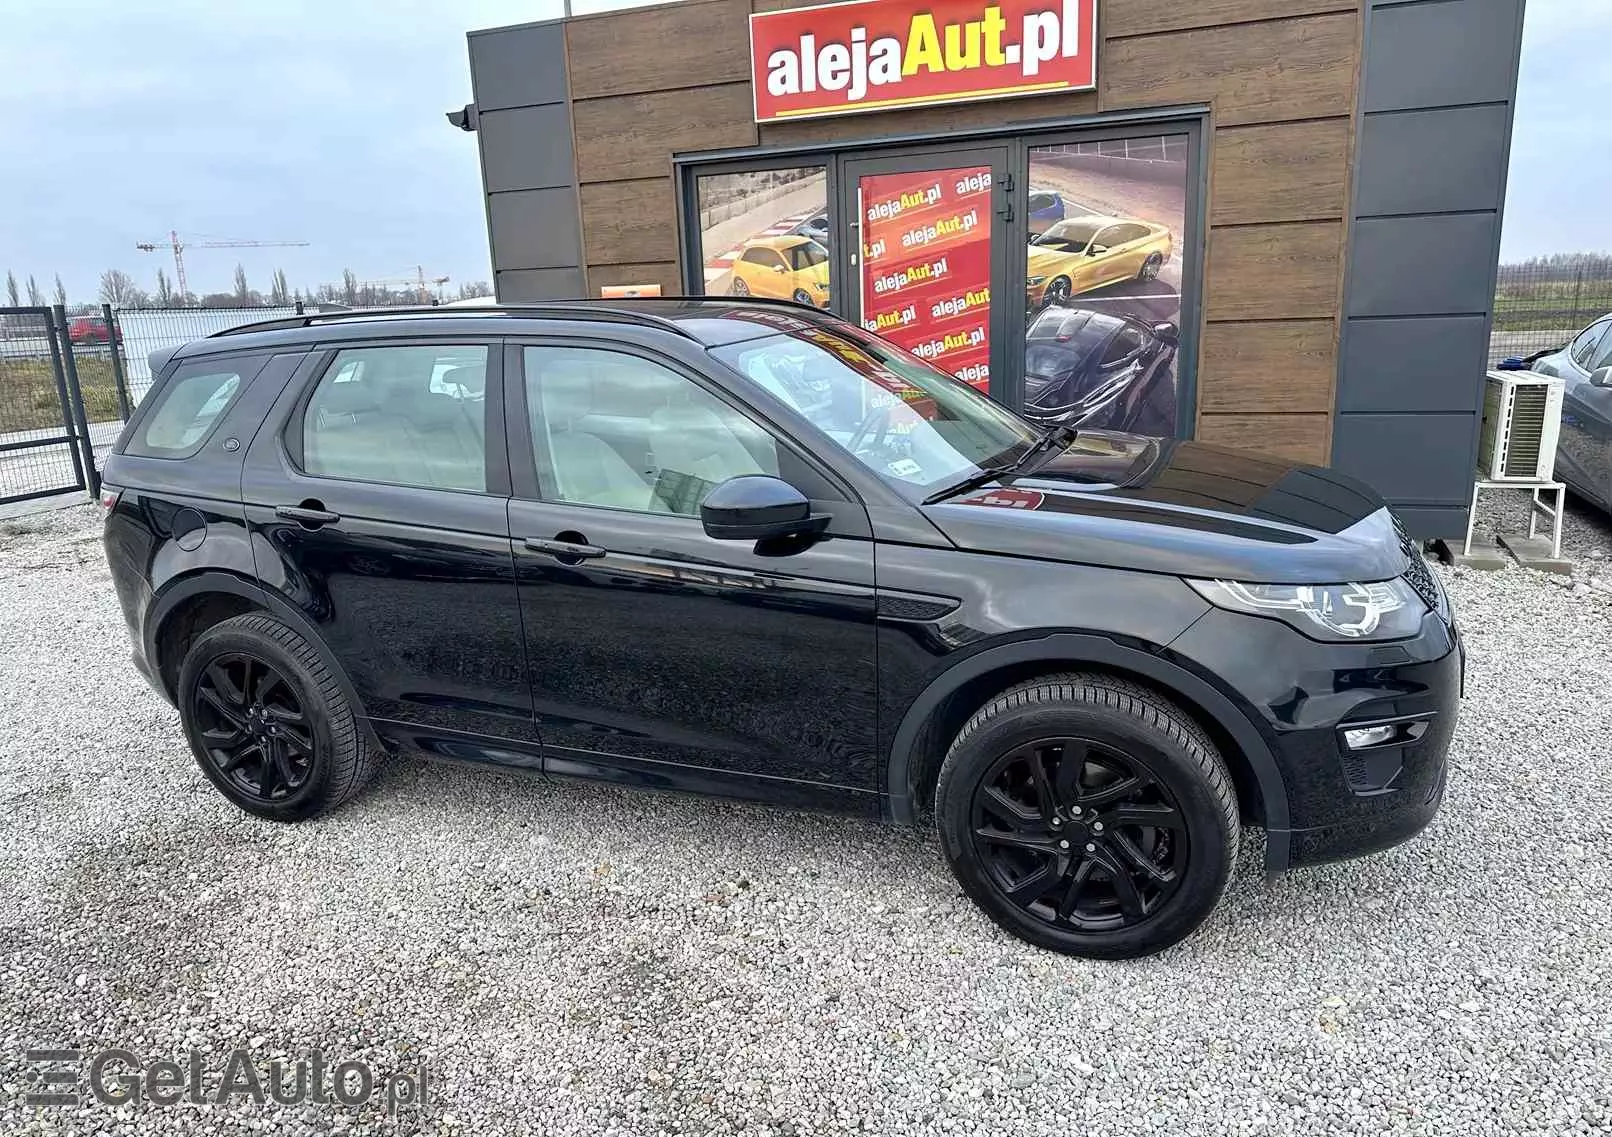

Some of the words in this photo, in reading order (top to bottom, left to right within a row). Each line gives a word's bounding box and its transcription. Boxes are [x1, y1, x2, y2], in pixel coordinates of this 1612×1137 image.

[767, 0, 1079, 101] alejaAut.pl
[955, 172, 991, 194] aleja
[867, 183, 942, 220] alejaAut.pl
[902, 209, 978, 247] alejaAut.pl
[874, 257, 948, 293] alejaAut.pl
[931, 288, 990, 317] alejaAut
